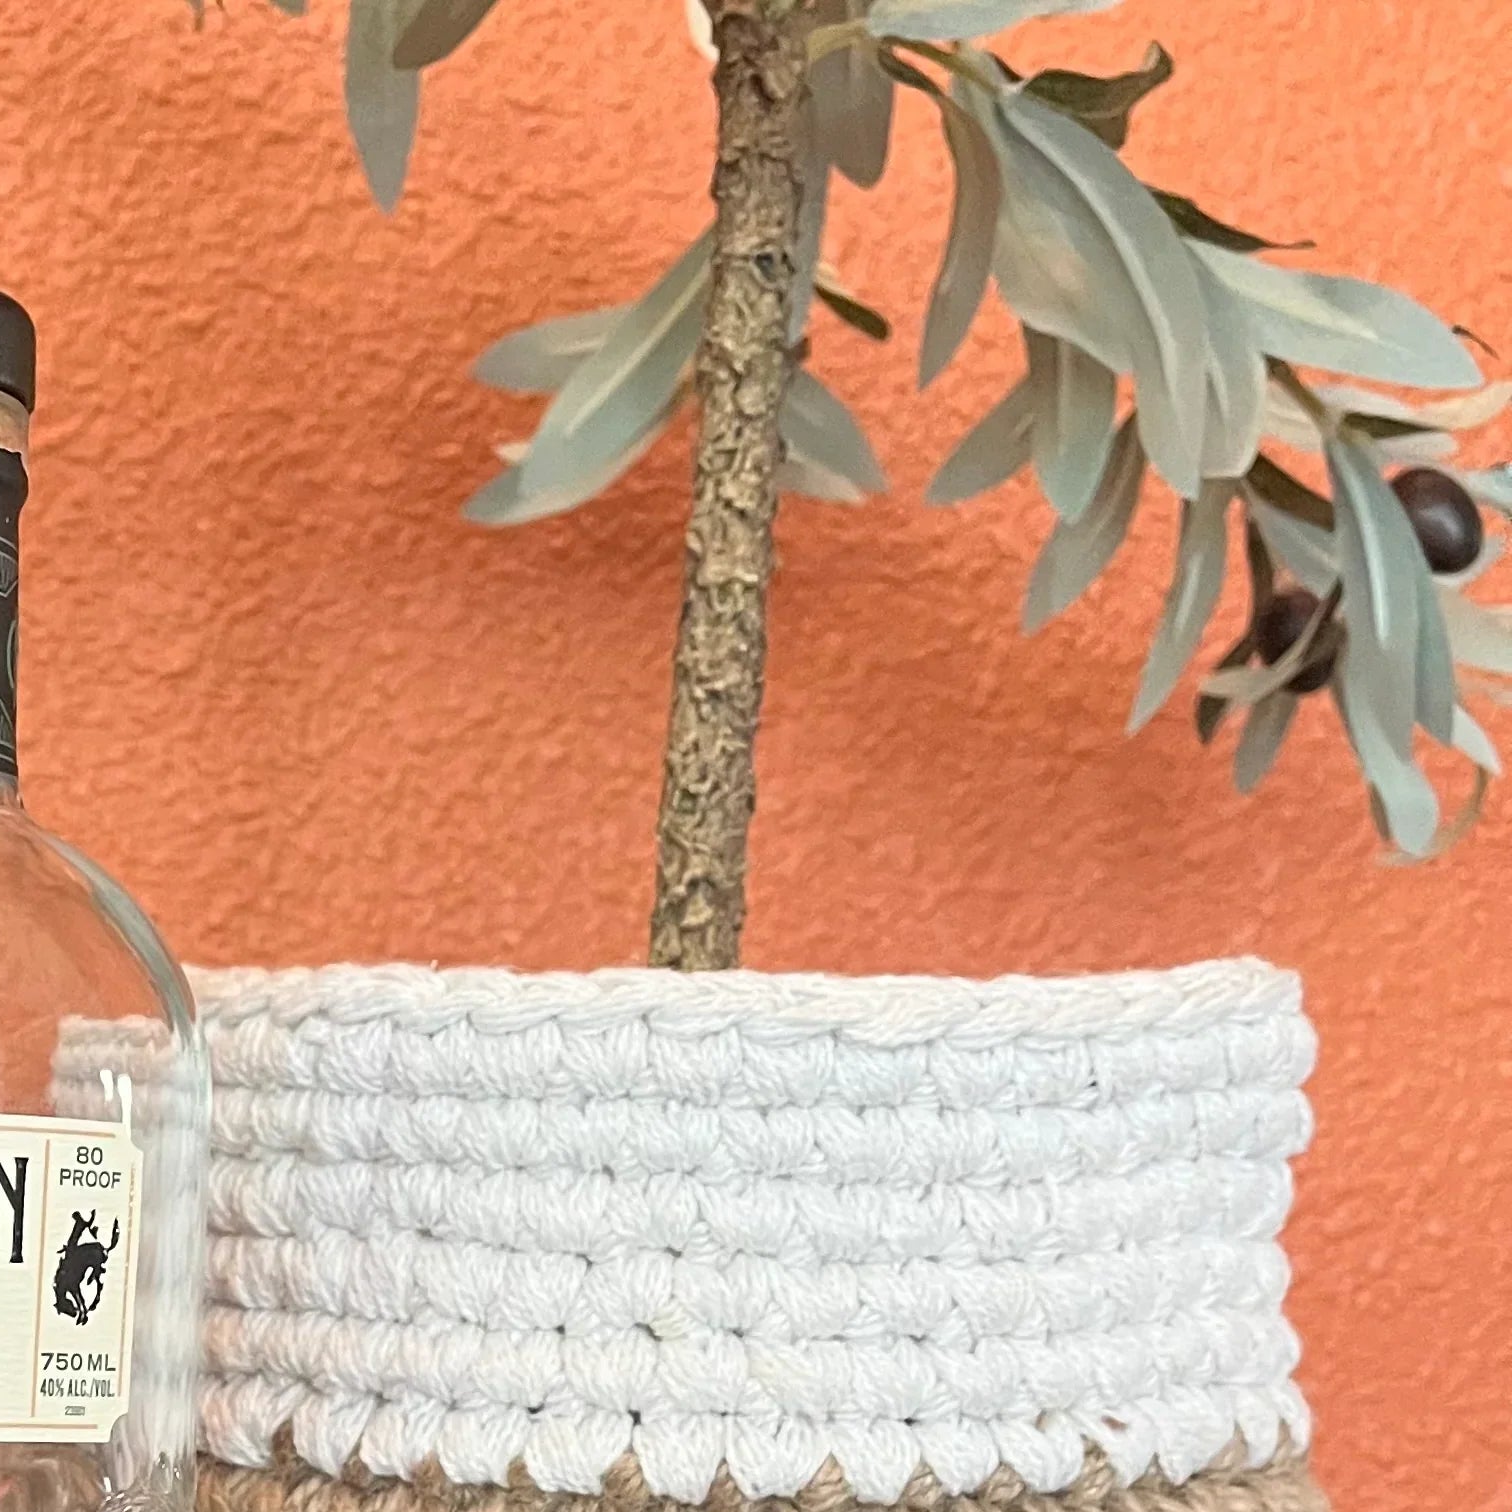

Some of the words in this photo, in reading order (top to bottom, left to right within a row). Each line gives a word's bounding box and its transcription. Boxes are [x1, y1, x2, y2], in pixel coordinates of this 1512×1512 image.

[76, 1146, 103, 1165] 80
[59, 1168, 122, 1189] PROOF
[41, 1352, 83, 1371] 750
[88, 1353, 116, 1371] ML
[40, 1378, 65, 1397] 40%
